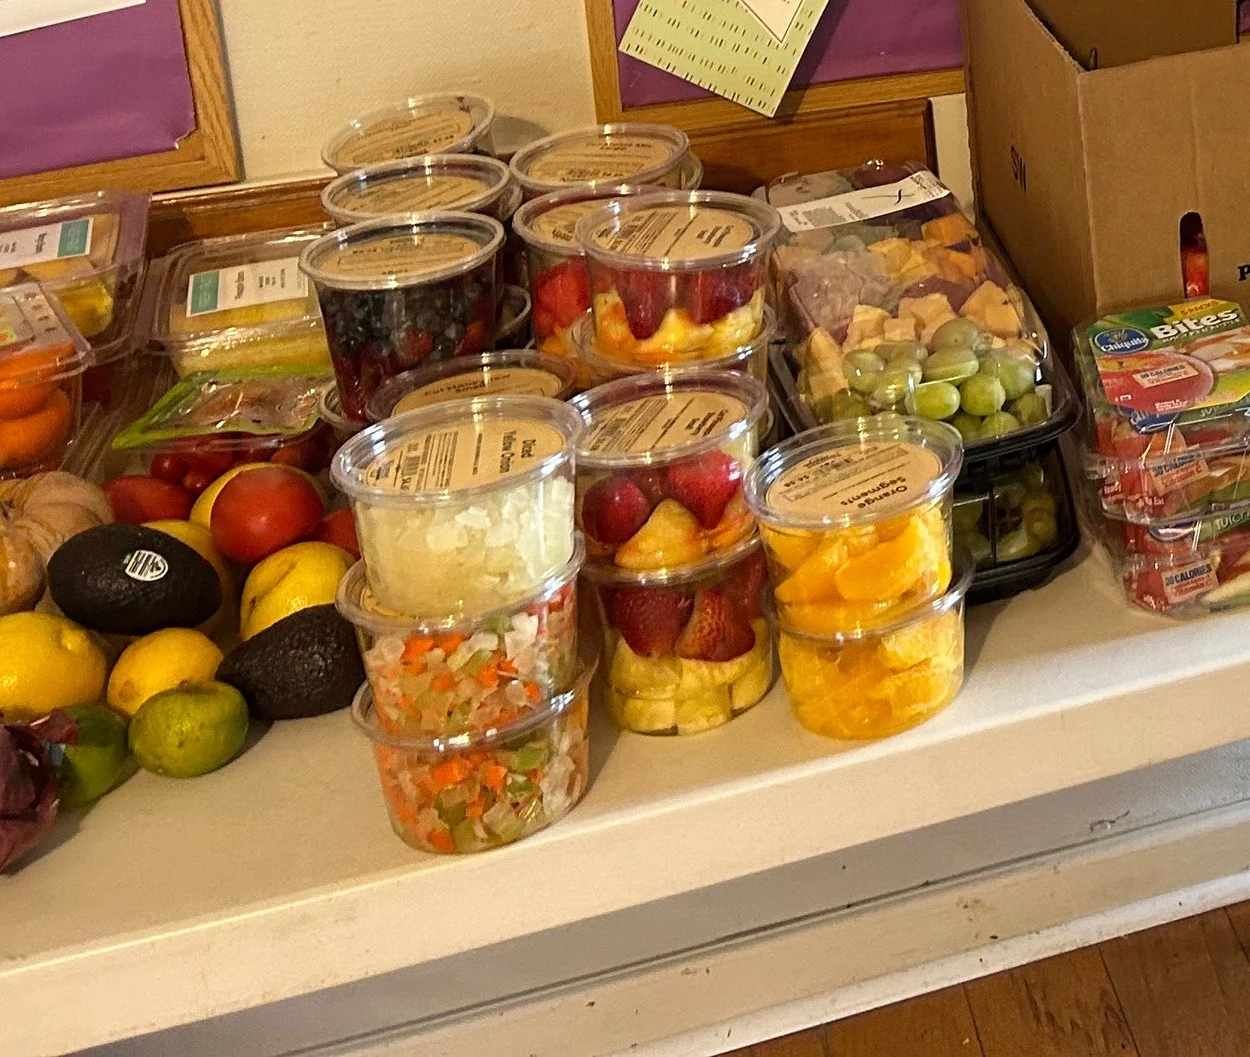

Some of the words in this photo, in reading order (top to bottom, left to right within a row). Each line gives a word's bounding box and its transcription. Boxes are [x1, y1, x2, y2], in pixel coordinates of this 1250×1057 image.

[1150, 308, 1239, 339] Bites
[1101, 337, 1150, 352] Chiquita
[503, 430, 516, 451] Yellow
[522, 438, 536, 458] Diced
[500, 452, 514, 474] Onion
[840, 476, 907, 506] Segments
[858, 484, 908, 508] Orange
[1174, 564, 1212, 582] CALORIES
